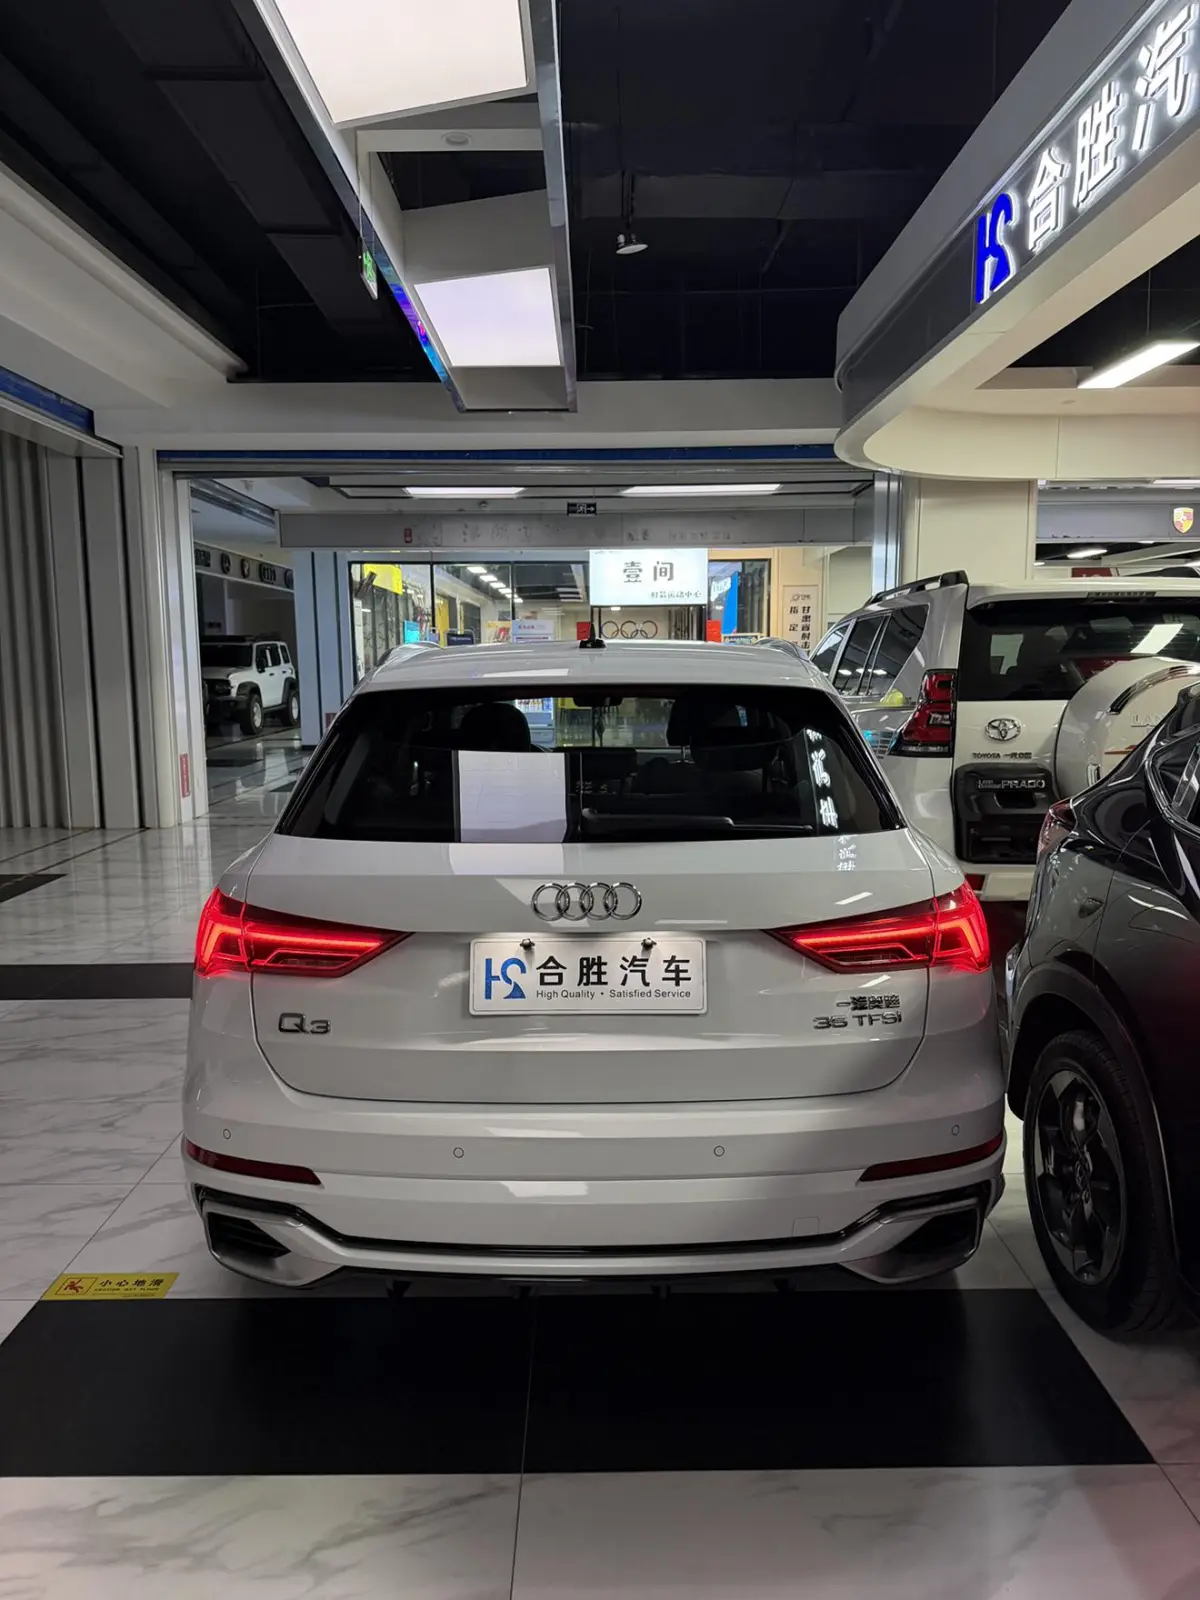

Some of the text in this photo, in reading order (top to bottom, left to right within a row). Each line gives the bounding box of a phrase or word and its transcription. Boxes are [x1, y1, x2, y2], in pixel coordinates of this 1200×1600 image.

[1026, 3, 1200, 252] 合胜汽
[623, 560, 675, 583] 壹间
[1001, 779, 1046, 789] PRADO
[535, 955, 692, 987] 合胜汽车
[536, 989, 692, 1001] High Quality Satisfied Service
[278, 1012, 332, 1035] Q3
[812, 1014, 849, 1030] 35
[100, 1279, 164, 1287] 小心地滑
